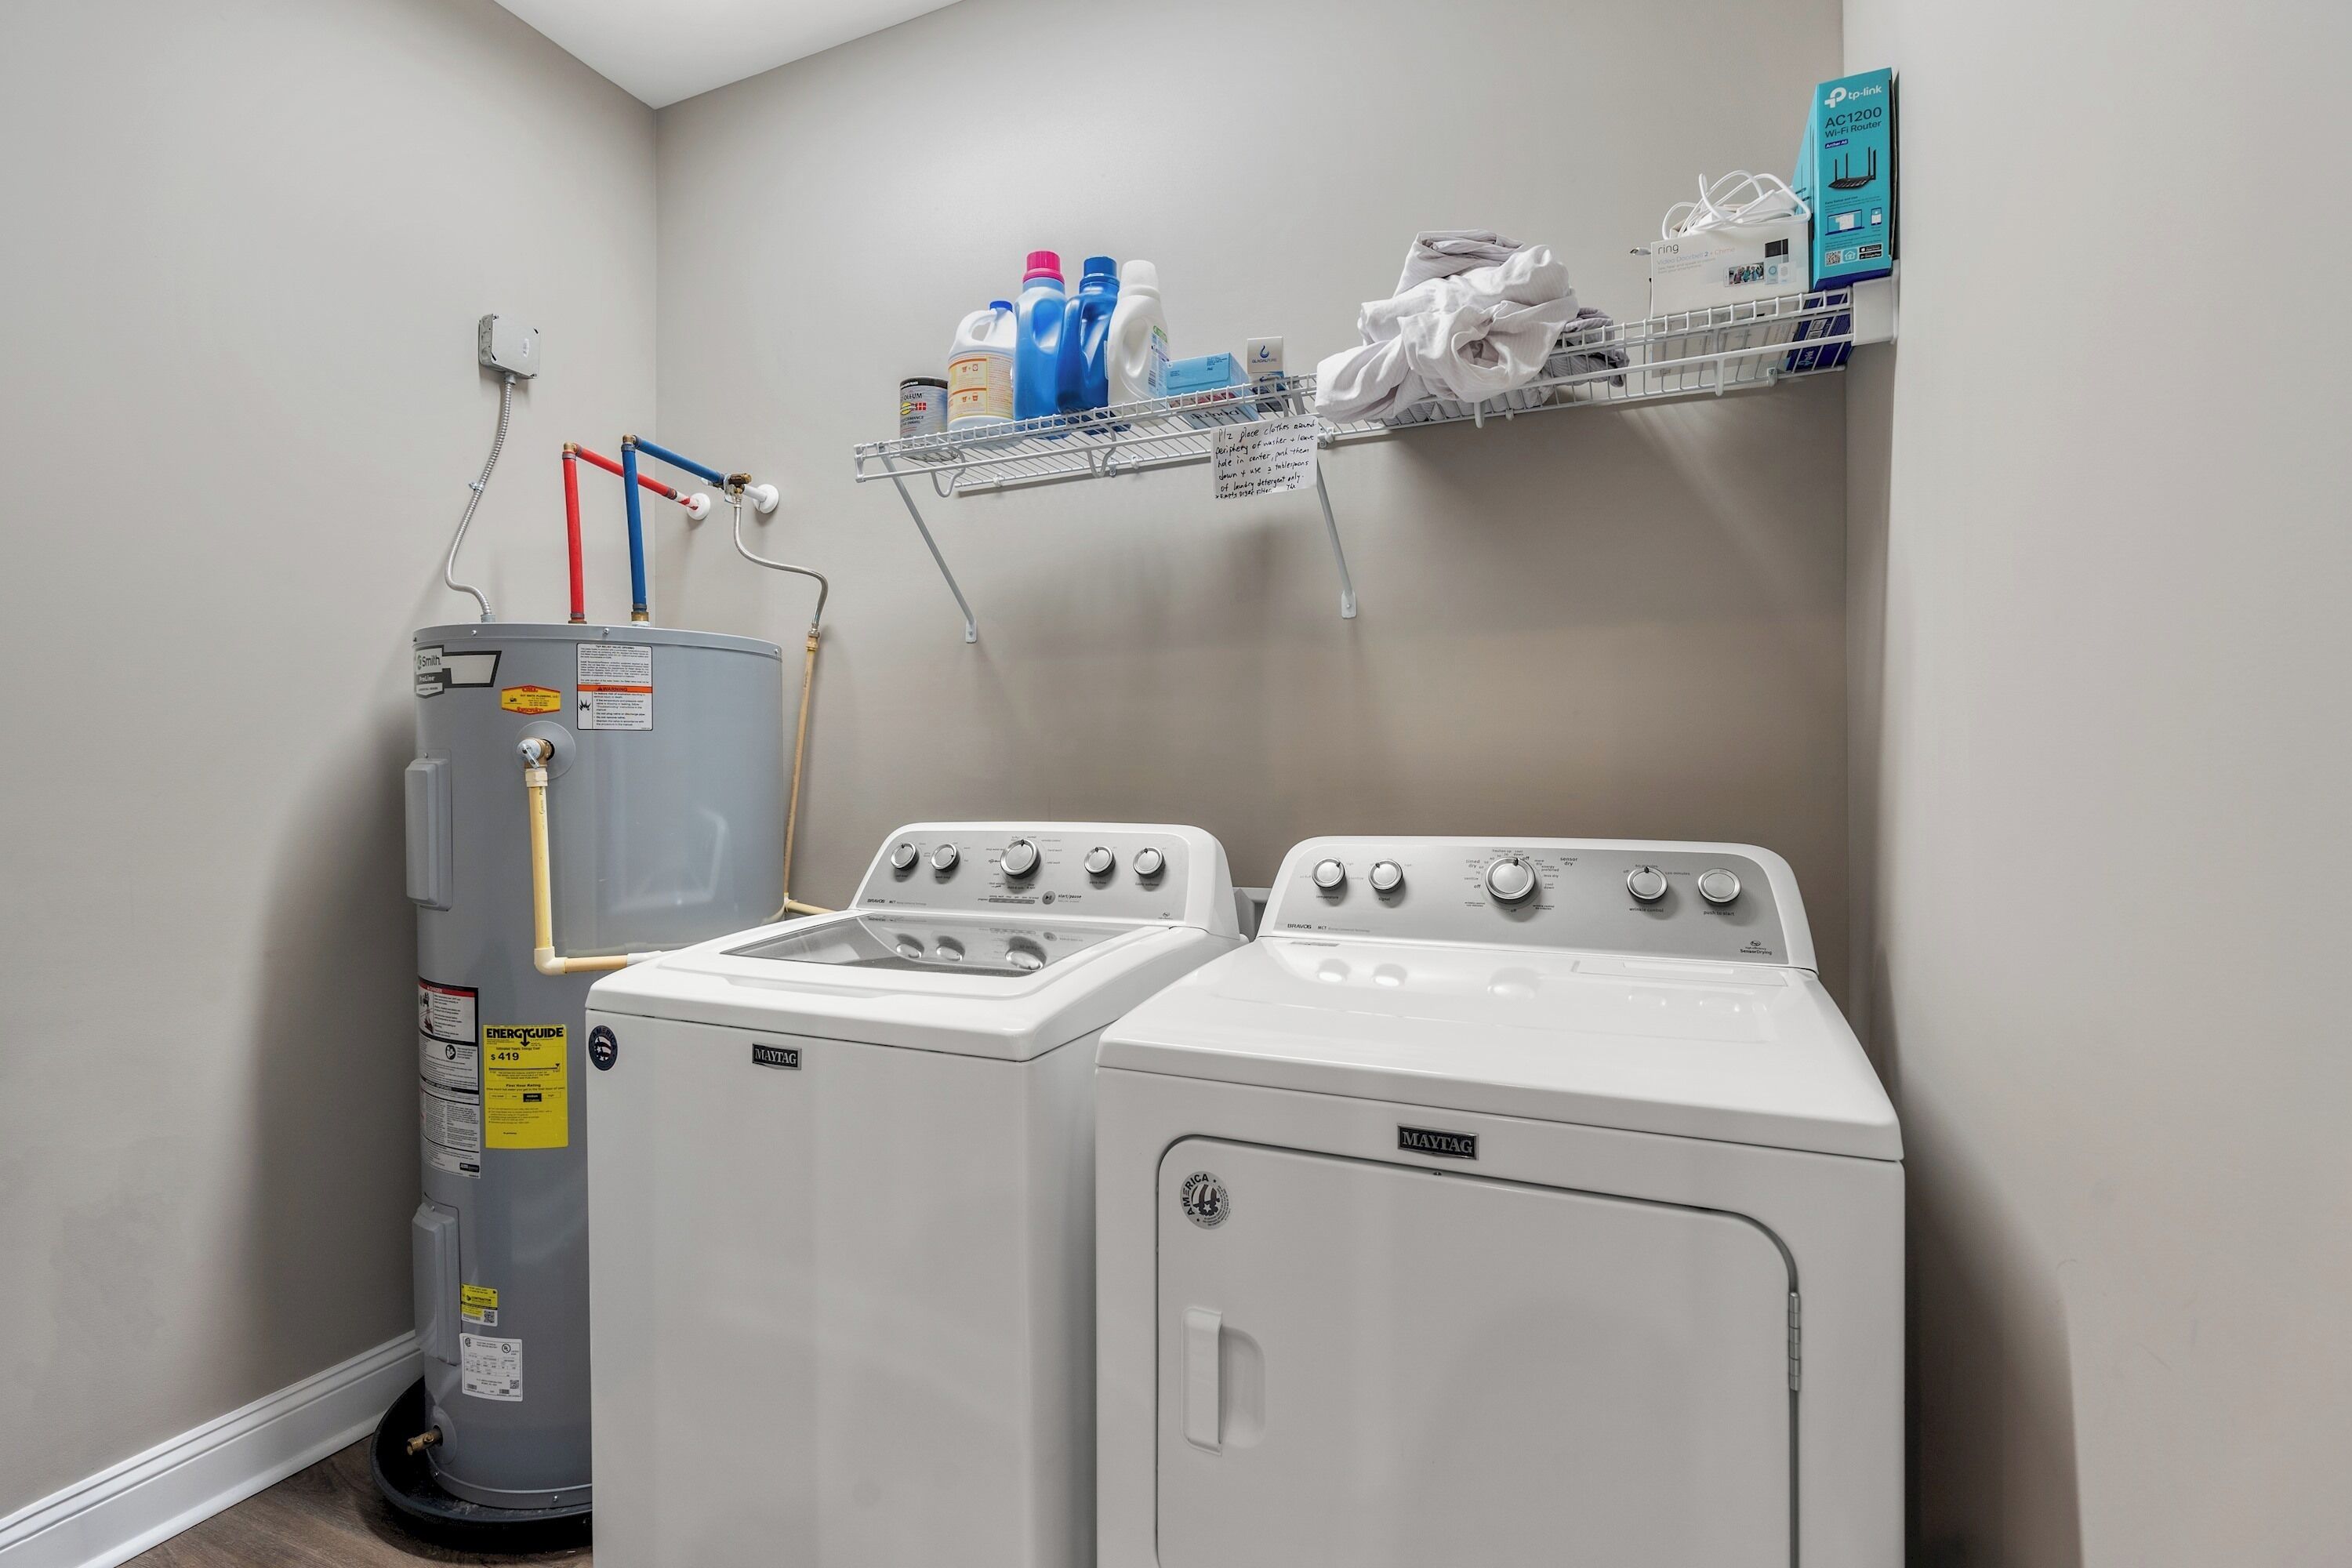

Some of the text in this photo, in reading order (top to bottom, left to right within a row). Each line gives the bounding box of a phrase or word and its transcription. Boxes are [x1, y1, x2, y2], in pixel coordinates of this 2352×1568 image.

[1848, 85, 1882, 100] tp-link
[1824, 107, 1882, 129] AC1200
[1824, 121, 1882, 138] Wi-Fi Router
[1657, 244, 1679, 255] ring
[1677, 252, 1704, 263] Doorbell
[1218, 419, 1316, 443] Plz place clothes around
[1215, 444, 1248, 459] periphery
[1263, 437, 1287, 446] washer
[1218, 459, 1232, 468] hole
[1236, 456, 1244, 464] in
[1275, 449, 1288, 461] push
[1218, 470, 1237, 481] down
[1276, 460, 1309, 470] tablespoons
[1233, 481, 1254, 491] laundry
[1257, 475, 1286, 488] detergent
[486, 1027, 564, 1039] ENERGYGUIDE
[498, 1052, 519, 1061] 419
[755, 1048, 797, 1065] MAYTAG
[1402, 1130, 1473, 1154] MAYTAG
[1182, 1174, 1209, 1215] AMERICA
